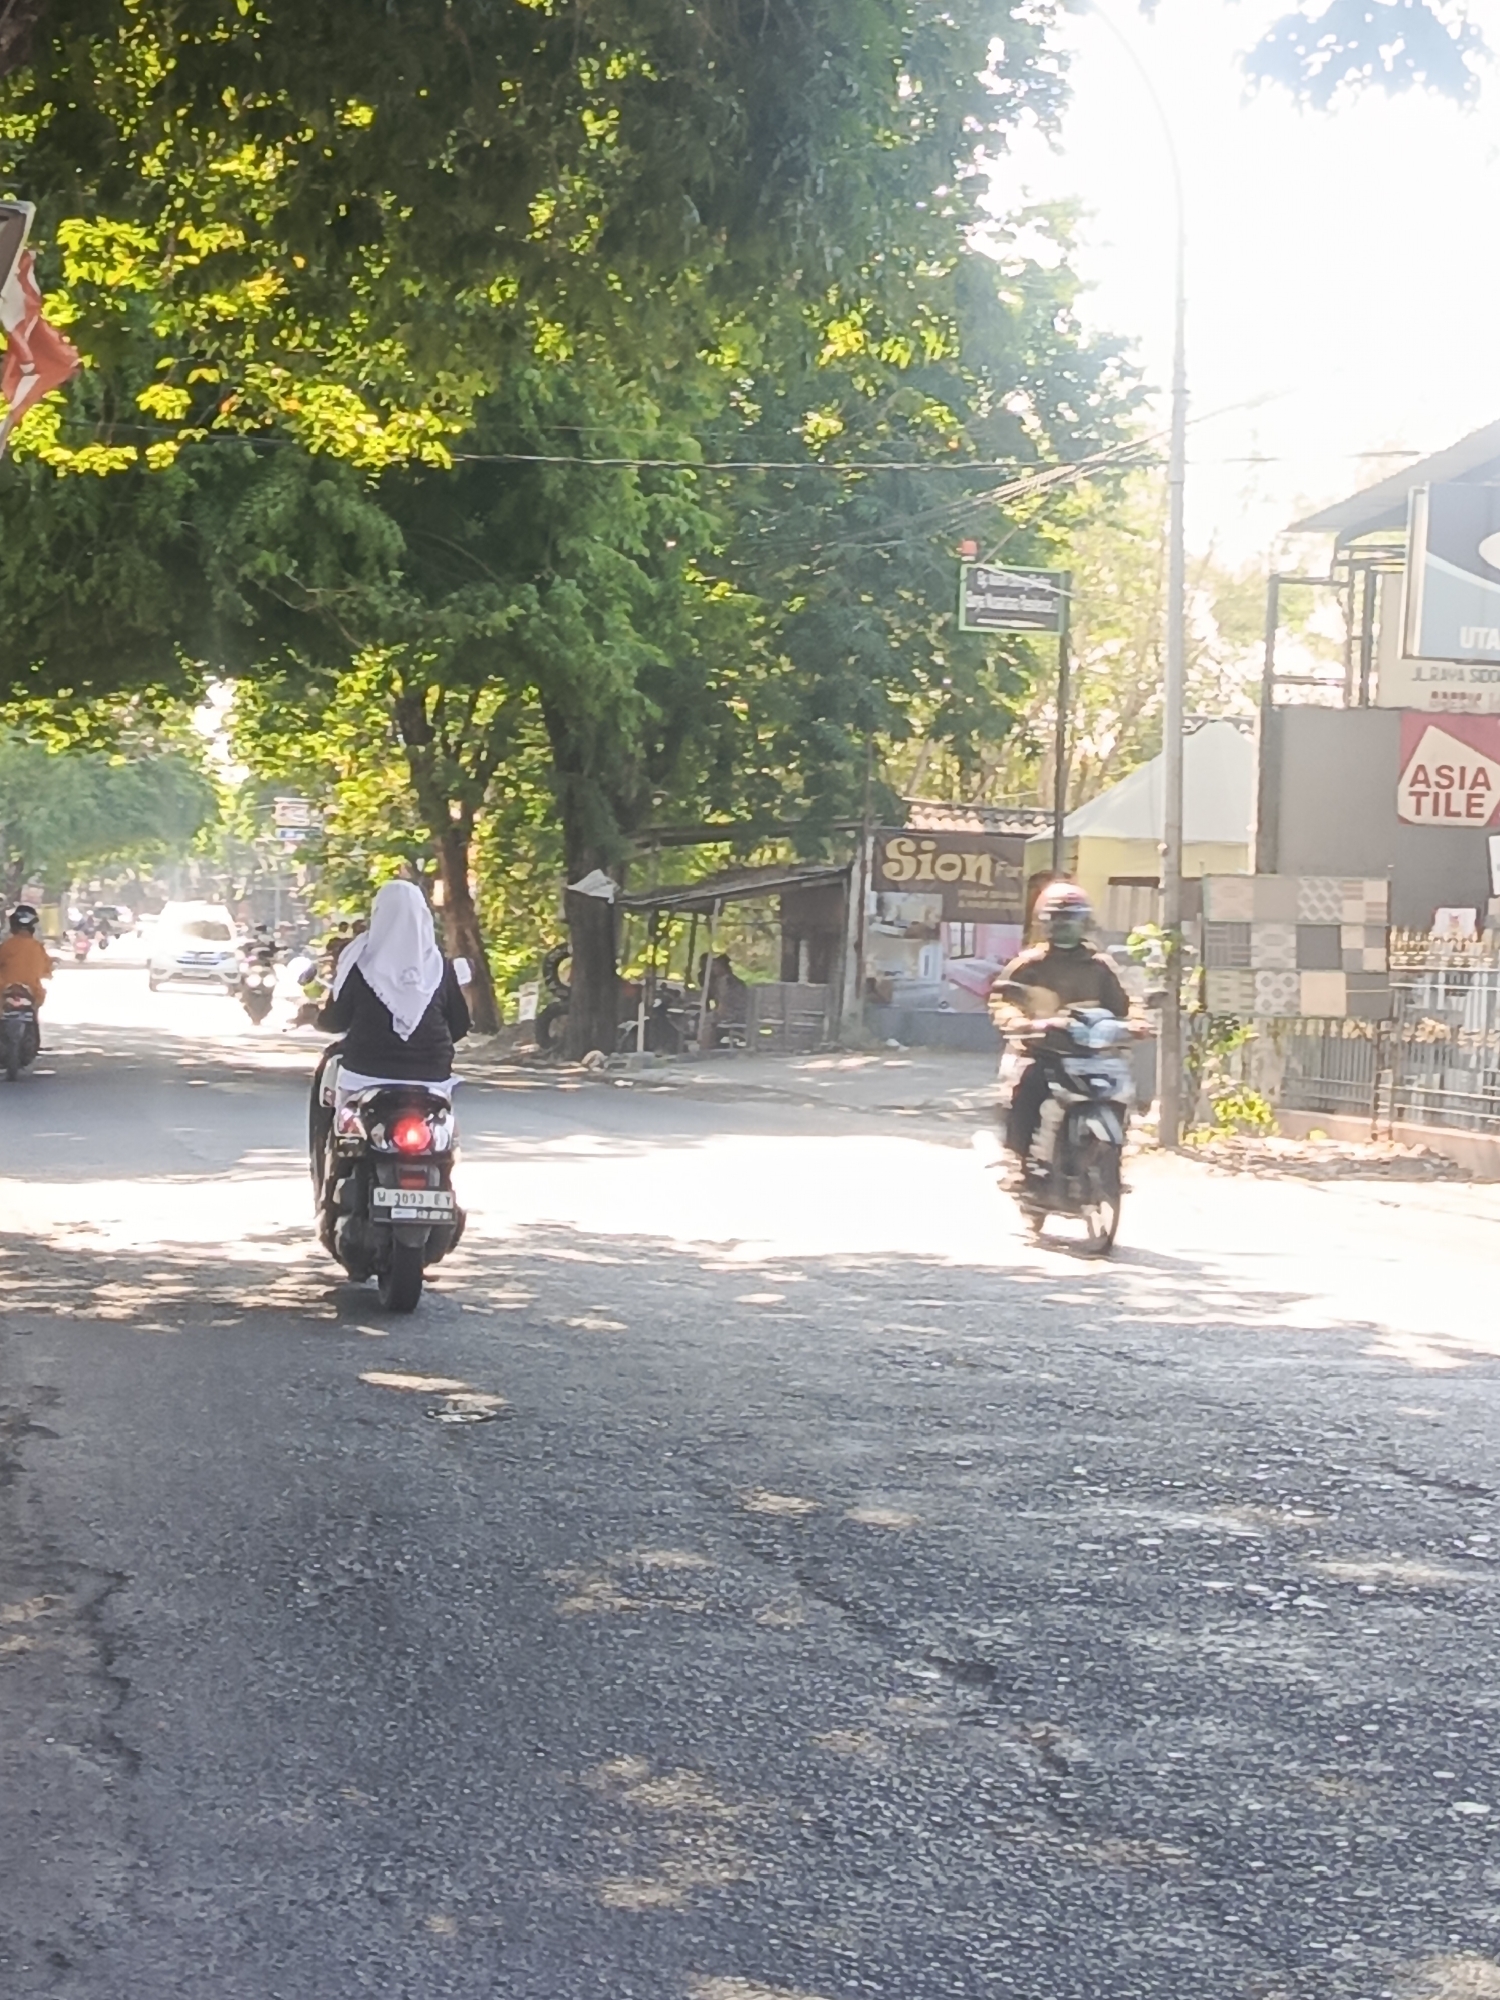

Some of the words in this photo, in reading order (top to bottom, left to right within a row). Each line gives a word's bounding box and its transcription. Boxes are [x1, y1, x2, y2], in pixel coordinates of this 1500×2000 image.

[1409, 764, 1492, 791] ASIA
[1408, 791, 1485, 818] TILE
[882, 837, 994, 887] Sion
